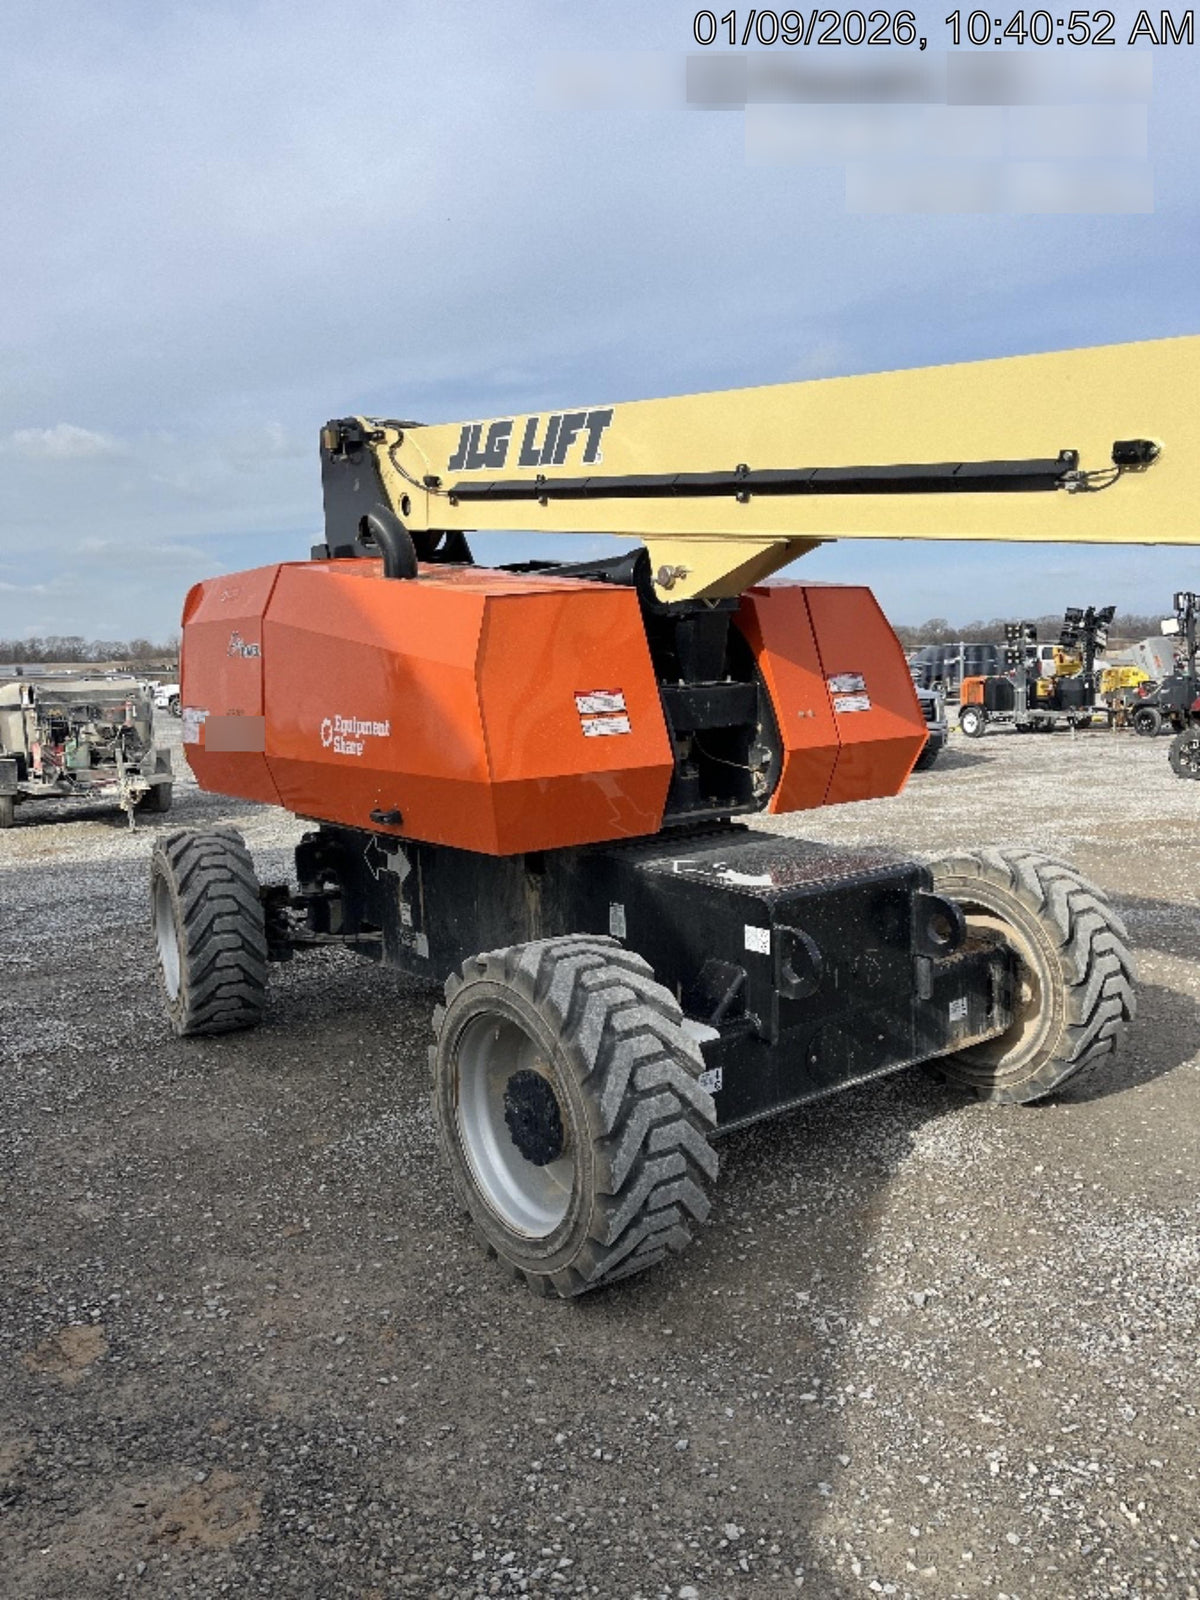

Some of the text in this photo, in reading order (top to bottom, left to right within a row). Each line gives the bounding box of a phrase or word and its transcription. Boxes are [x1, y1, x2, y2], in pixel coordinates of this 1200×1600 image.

[448, 407, 615, 472] JLG LIFT
[333, 714, 391, 738] Equipment
[333, 735, 363, 756] Share
